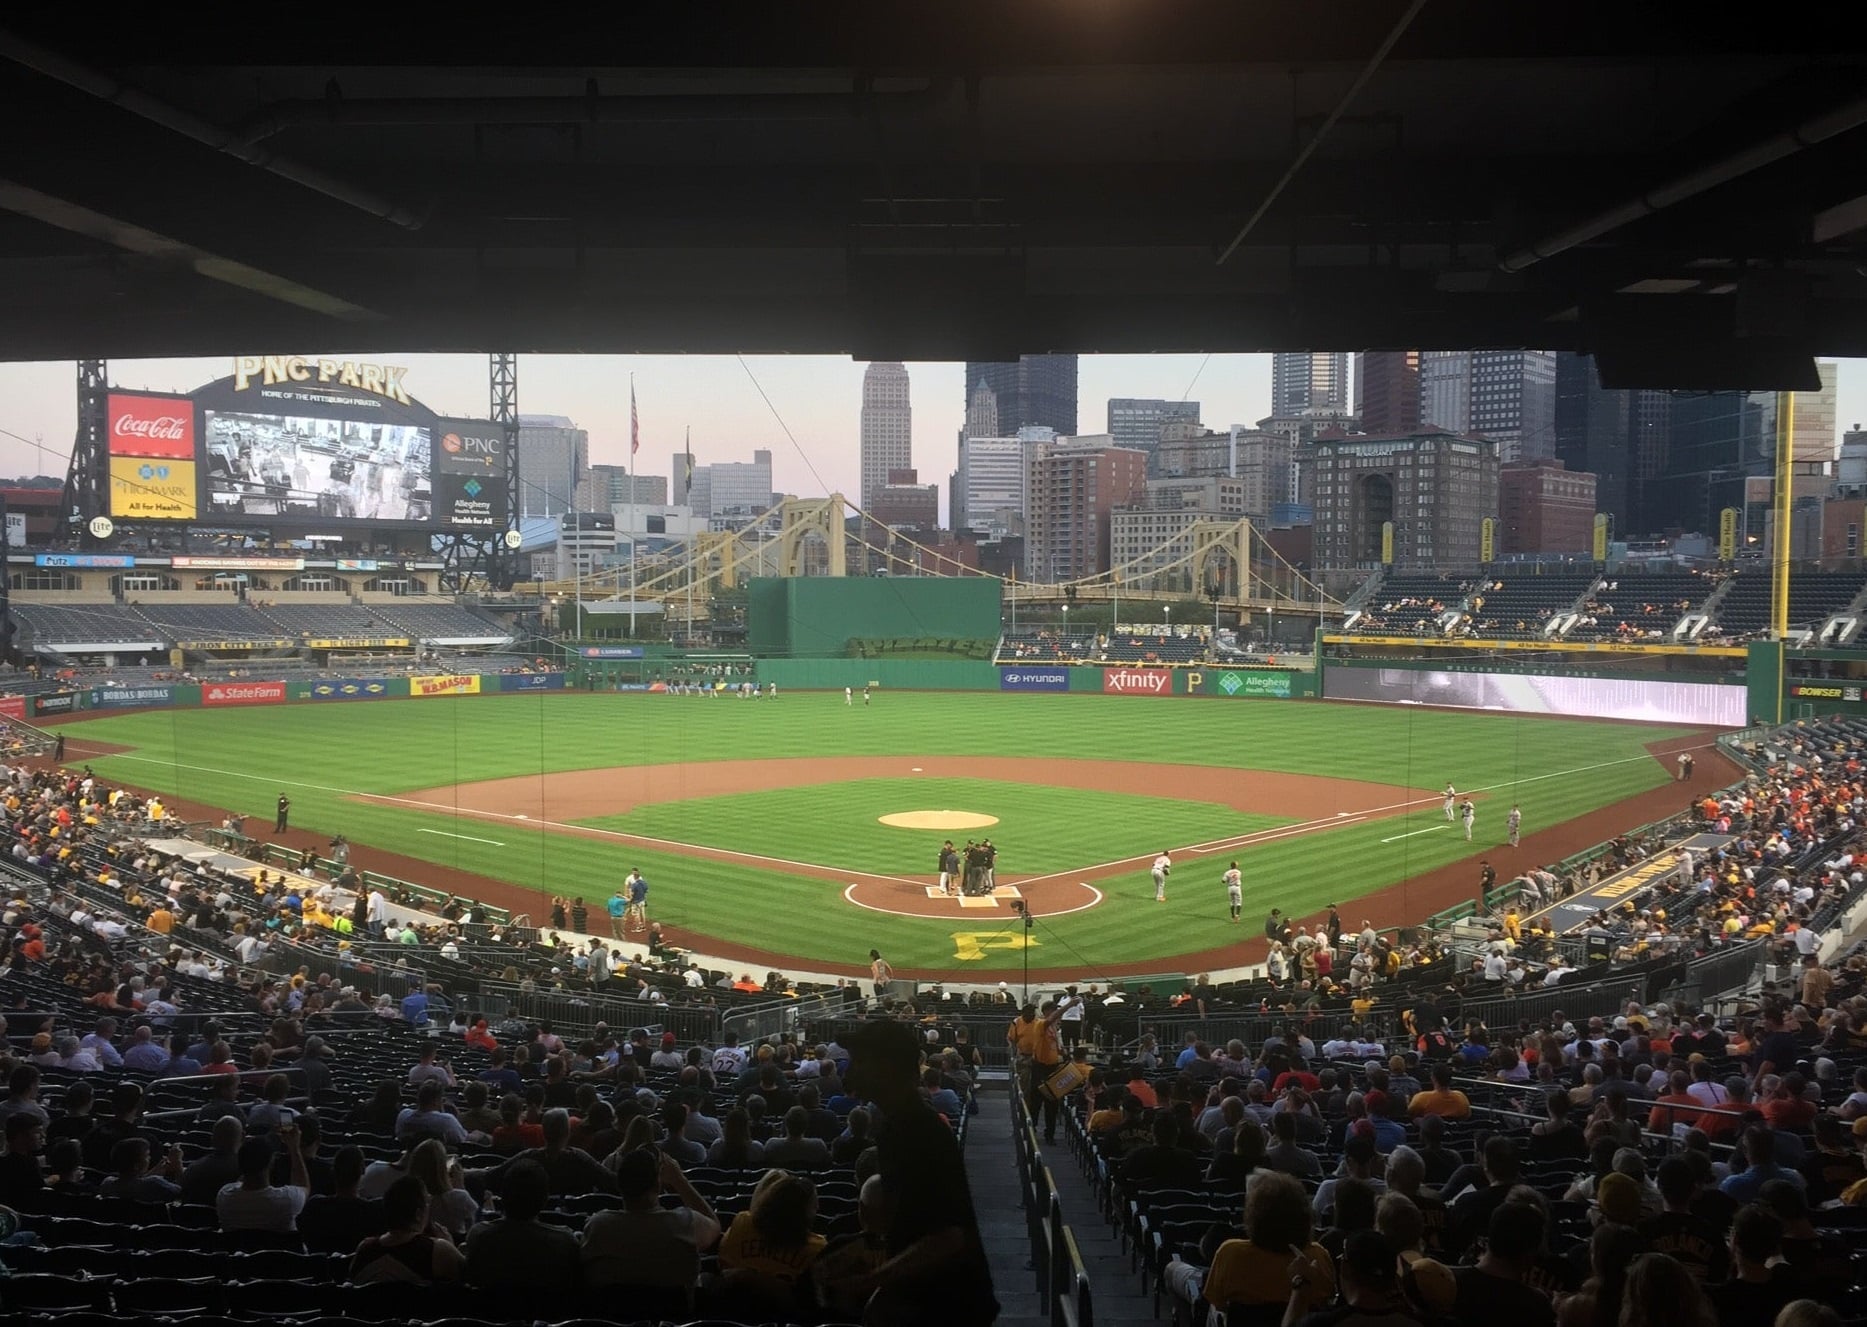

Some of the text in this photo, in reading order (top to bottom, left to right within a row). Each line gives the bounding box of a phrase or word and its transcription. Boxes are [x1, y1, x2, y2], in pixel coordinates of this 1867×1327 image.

[234, 355, 411, 406] PNC PARK
[261, 390, 283, 398] HOME
[295, 393, 310, 401] THE
[354, 398, 382, 408] PIRATES
[114, 414, 188, 440] Coca-Cola
[464, 437, 500, 454] PNC
[455, 500, 491, 510] Allegheny
[452, 516, 472, 524] Health
[92, 522, 110, 532] Lite
[507, 535, 520, 544] Lite
[532, 676, 546, 684] JDP
[1022, 675, 1064, 683] HYUNDAI
[1109, 670, 1167, 692] xfinity
[1187, 672, 1202, 692] P
[1246, 677, 1290, 688] Allegheny
[1798, 687, 1842, 697] BOWSER
[950, 930, 1043, 960] P
